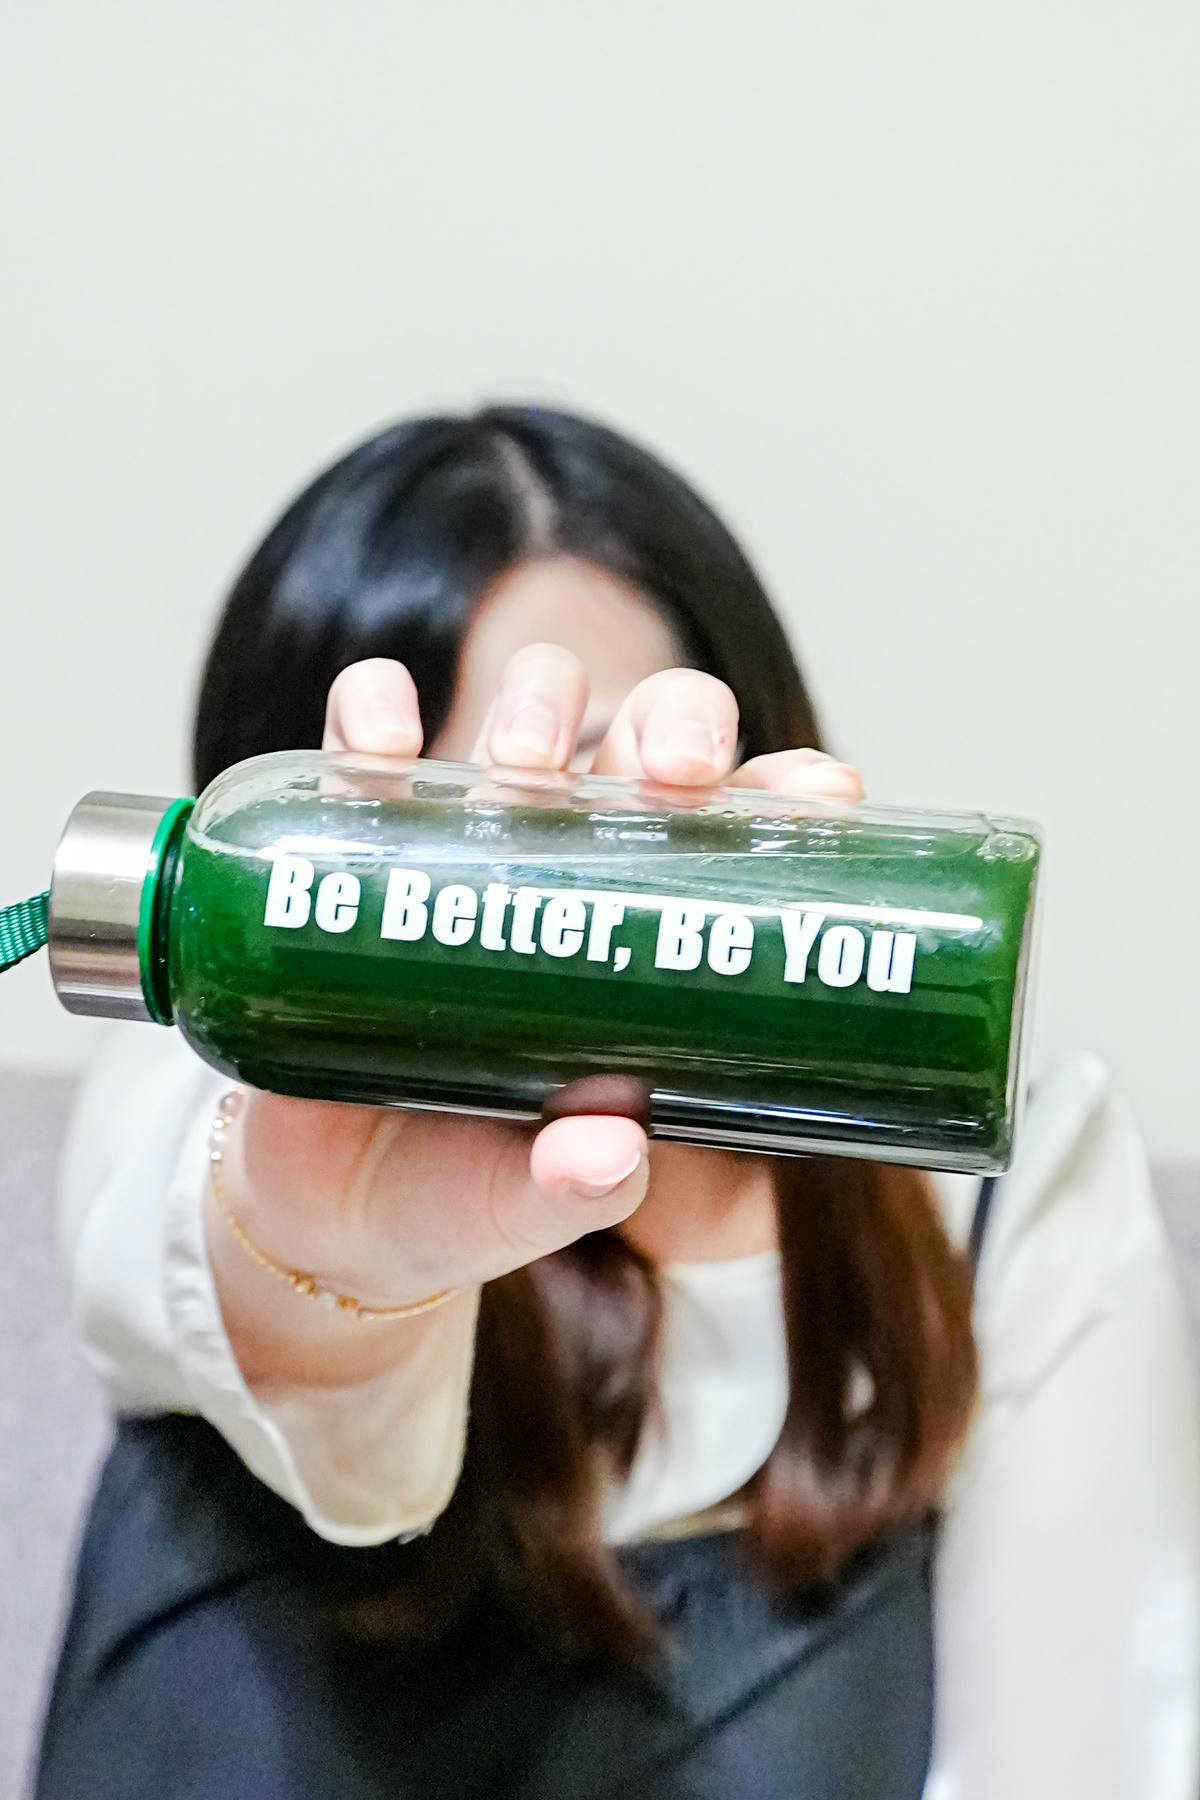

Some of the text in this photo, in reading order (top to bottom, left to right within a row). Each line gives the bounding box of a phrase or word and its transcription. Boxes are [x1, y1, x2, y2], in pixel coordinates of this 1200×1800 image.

[264, 857, 917, 993] Be Better, Be You
